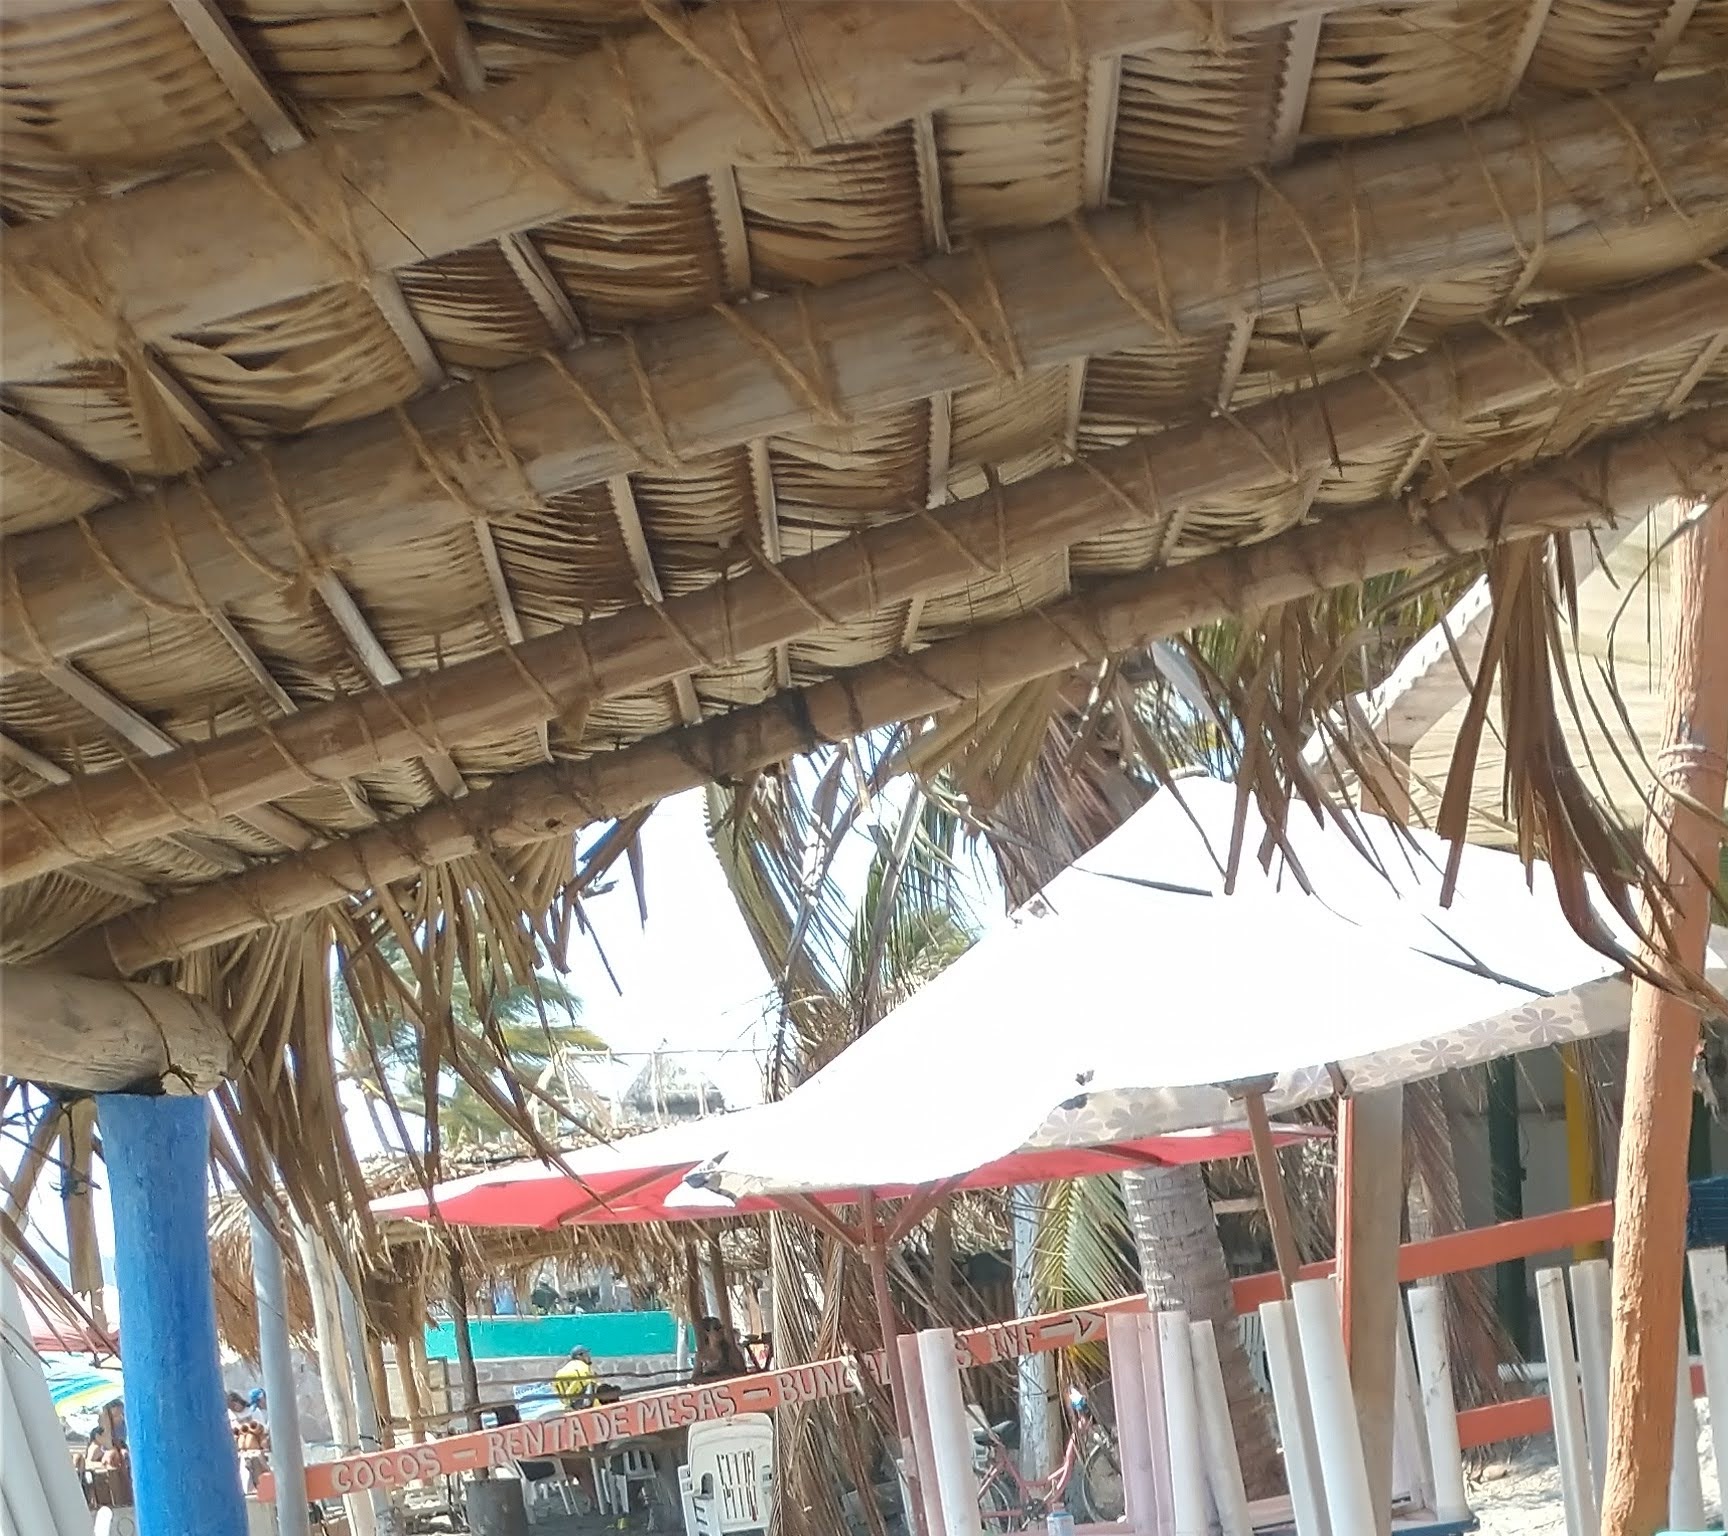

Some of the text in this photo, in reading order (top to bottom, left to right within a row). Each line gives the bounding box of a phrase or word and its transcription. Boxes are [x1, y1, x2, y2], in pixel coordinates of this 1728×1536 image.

[330, 1446, 441, 1492] COCOS
[488, 1415, 588, 1465] RENTA
[595, 1404, 632, 1442] DE
[636, 1385, 736, 1435] MESAS
